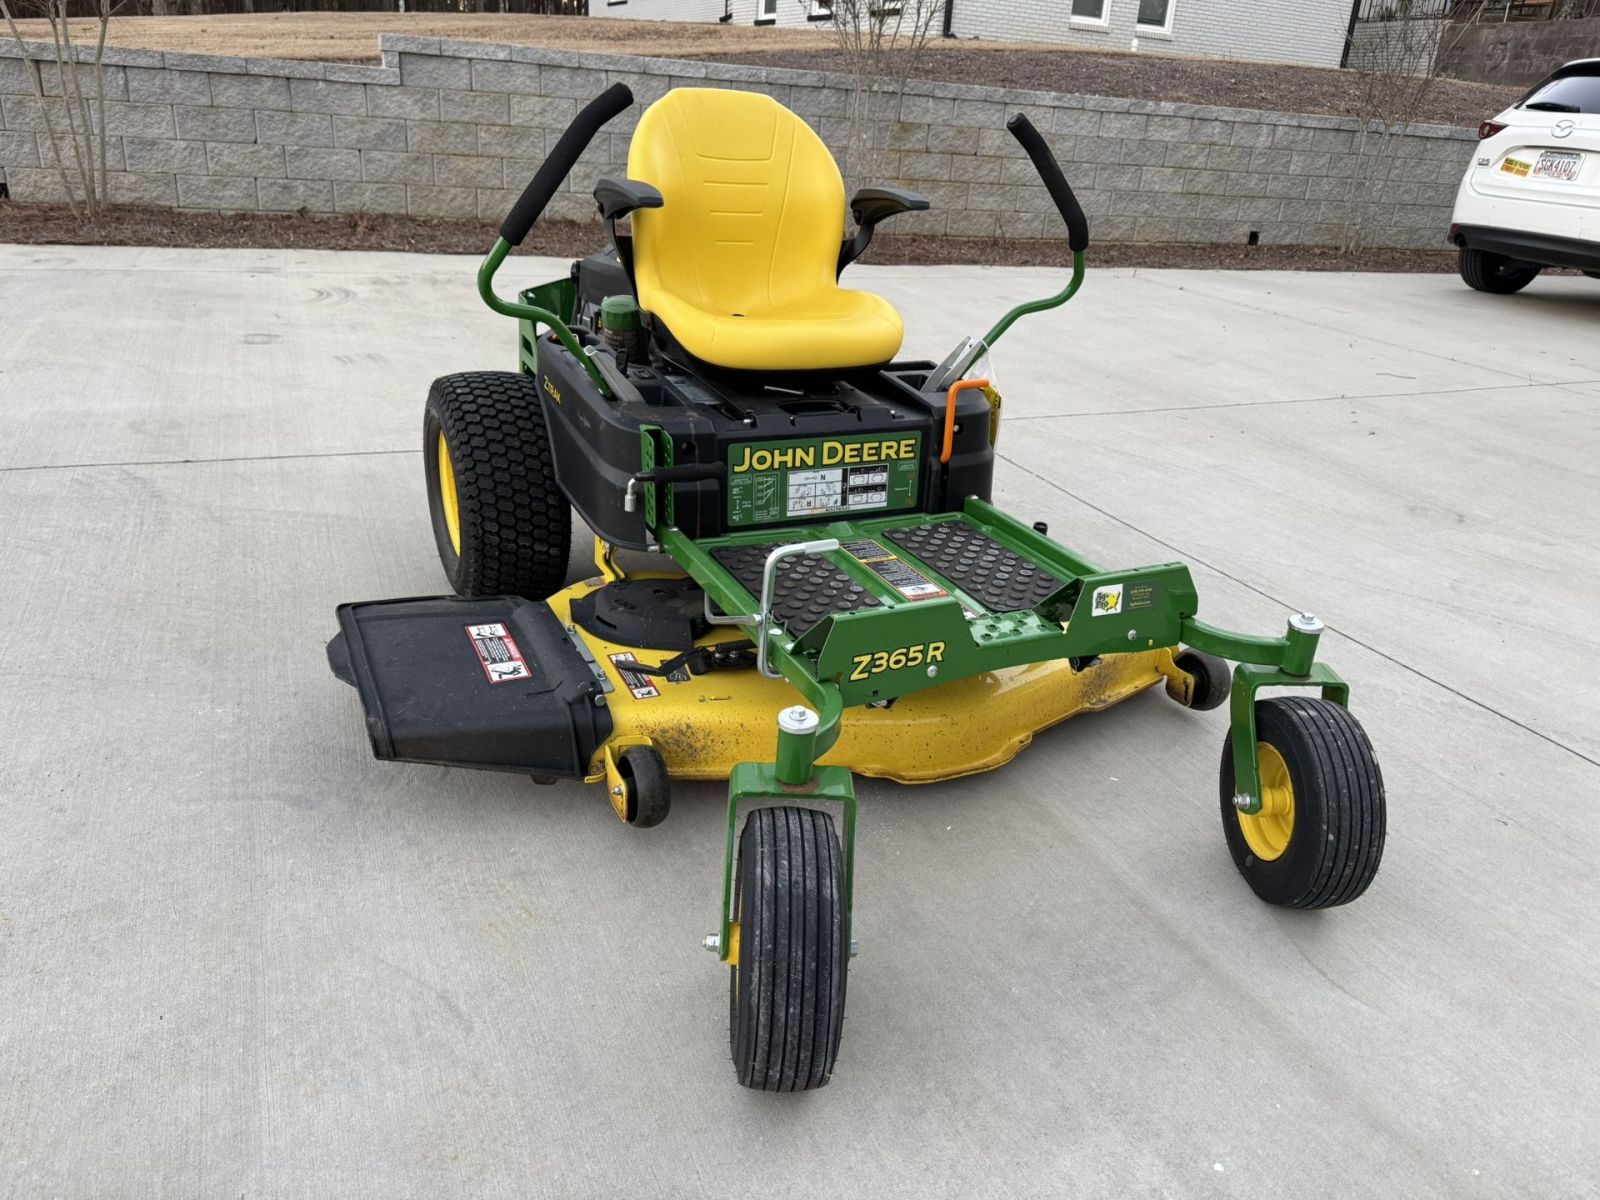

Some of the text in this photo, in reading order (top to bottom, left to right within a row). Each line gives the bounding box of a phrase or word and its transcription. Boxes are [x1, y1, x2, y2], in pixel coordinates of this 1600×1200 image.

[733, 440, 916, 473] JOHN DEERE
[850, 641, 945, 682] Z365R
